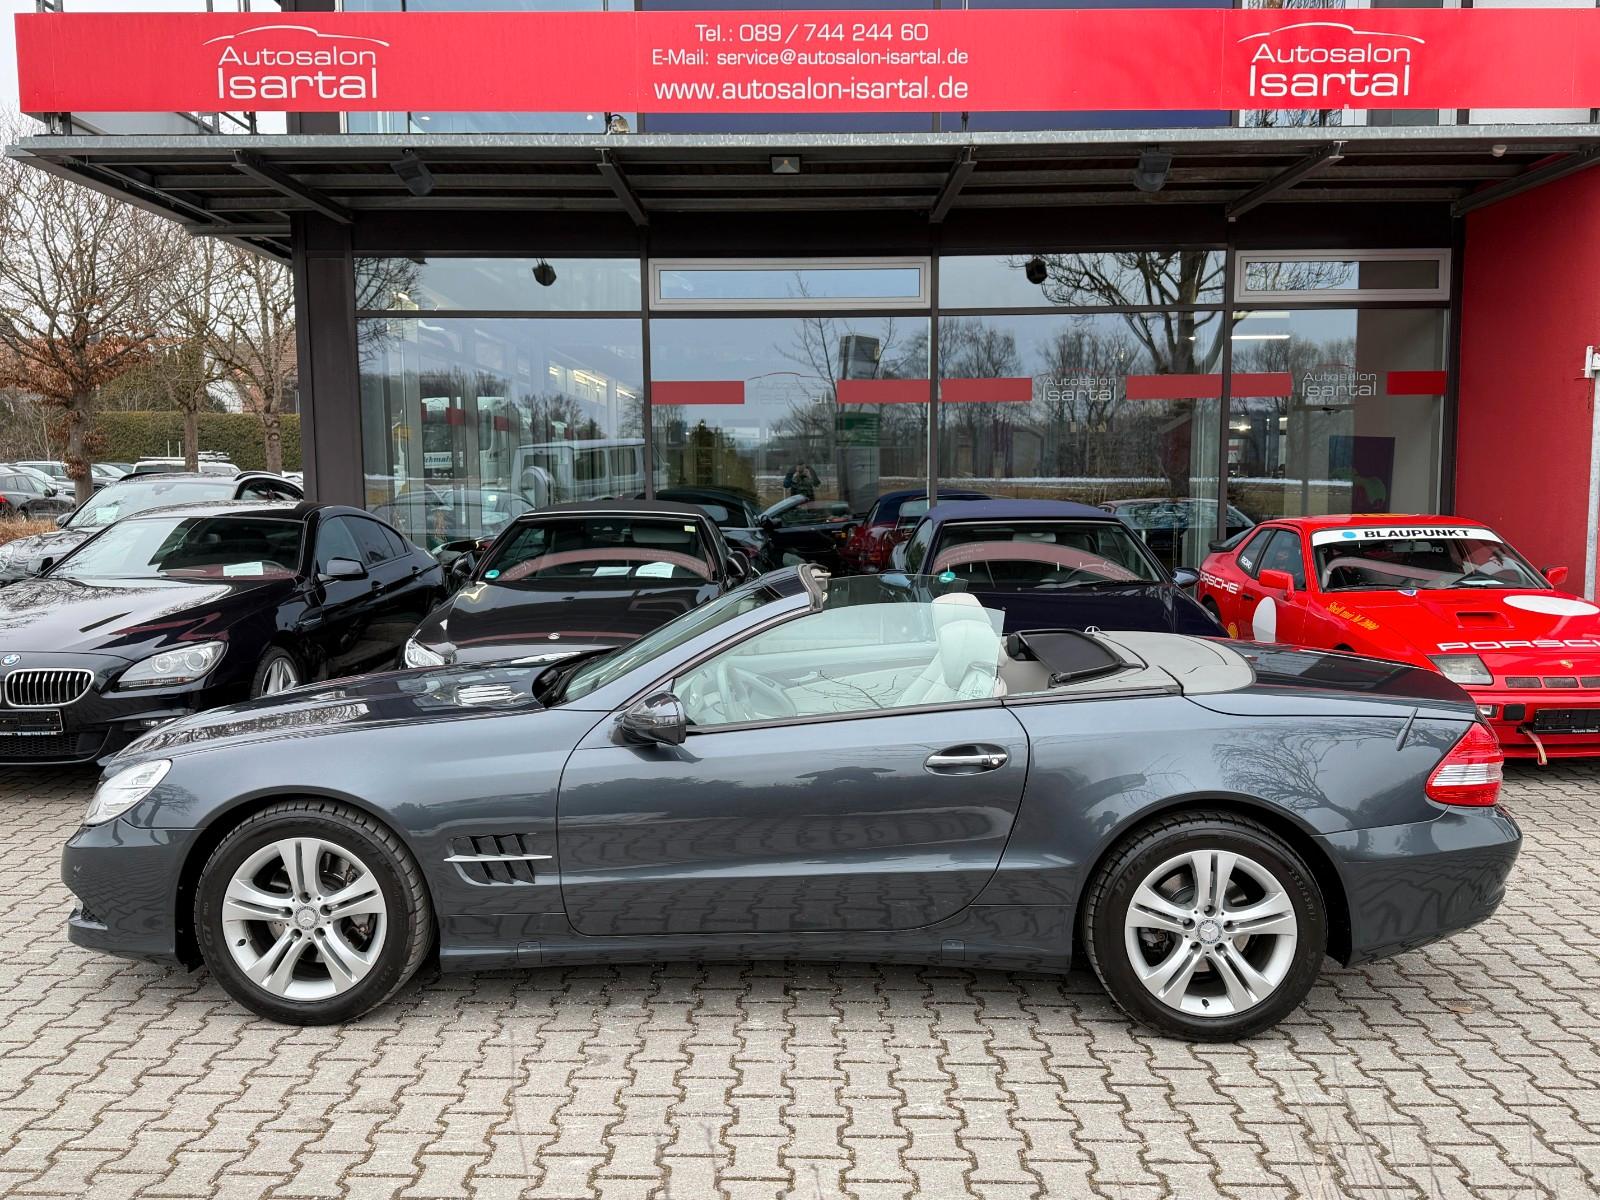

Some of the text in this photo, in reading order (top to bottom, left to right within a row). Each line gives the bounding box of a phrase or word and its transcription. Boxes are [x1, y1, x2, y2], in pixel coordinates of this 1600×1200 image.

[695, 23, 929, 44] Tel.: 089 / 744 244 60
[218, 45, 377, 66] Autosalon
[652, 48, 969, 66] E-Mail: service@autosalon-isartal.de
[1252, 42, 1411, 63] Autosalon
[217, 67, 377, 99] Isartal
[653, 76, 969, 100] www.autosalon-isartal.de
[1249, 65, 1410, 97] Isartal
[1044, 375, 1117, 386] Autosalon
[1302, 370, 1377, 382] Autosalon
[1042, 382, 1117, 401] Isartal
[1301, 380, 1377, 397] Isartal
[1363, 529, 1470, 538] BLAUPUNKT
[1200, 570, 1239, 595] ORSCHE
[1436, 639, 1600, 651] PORSC
